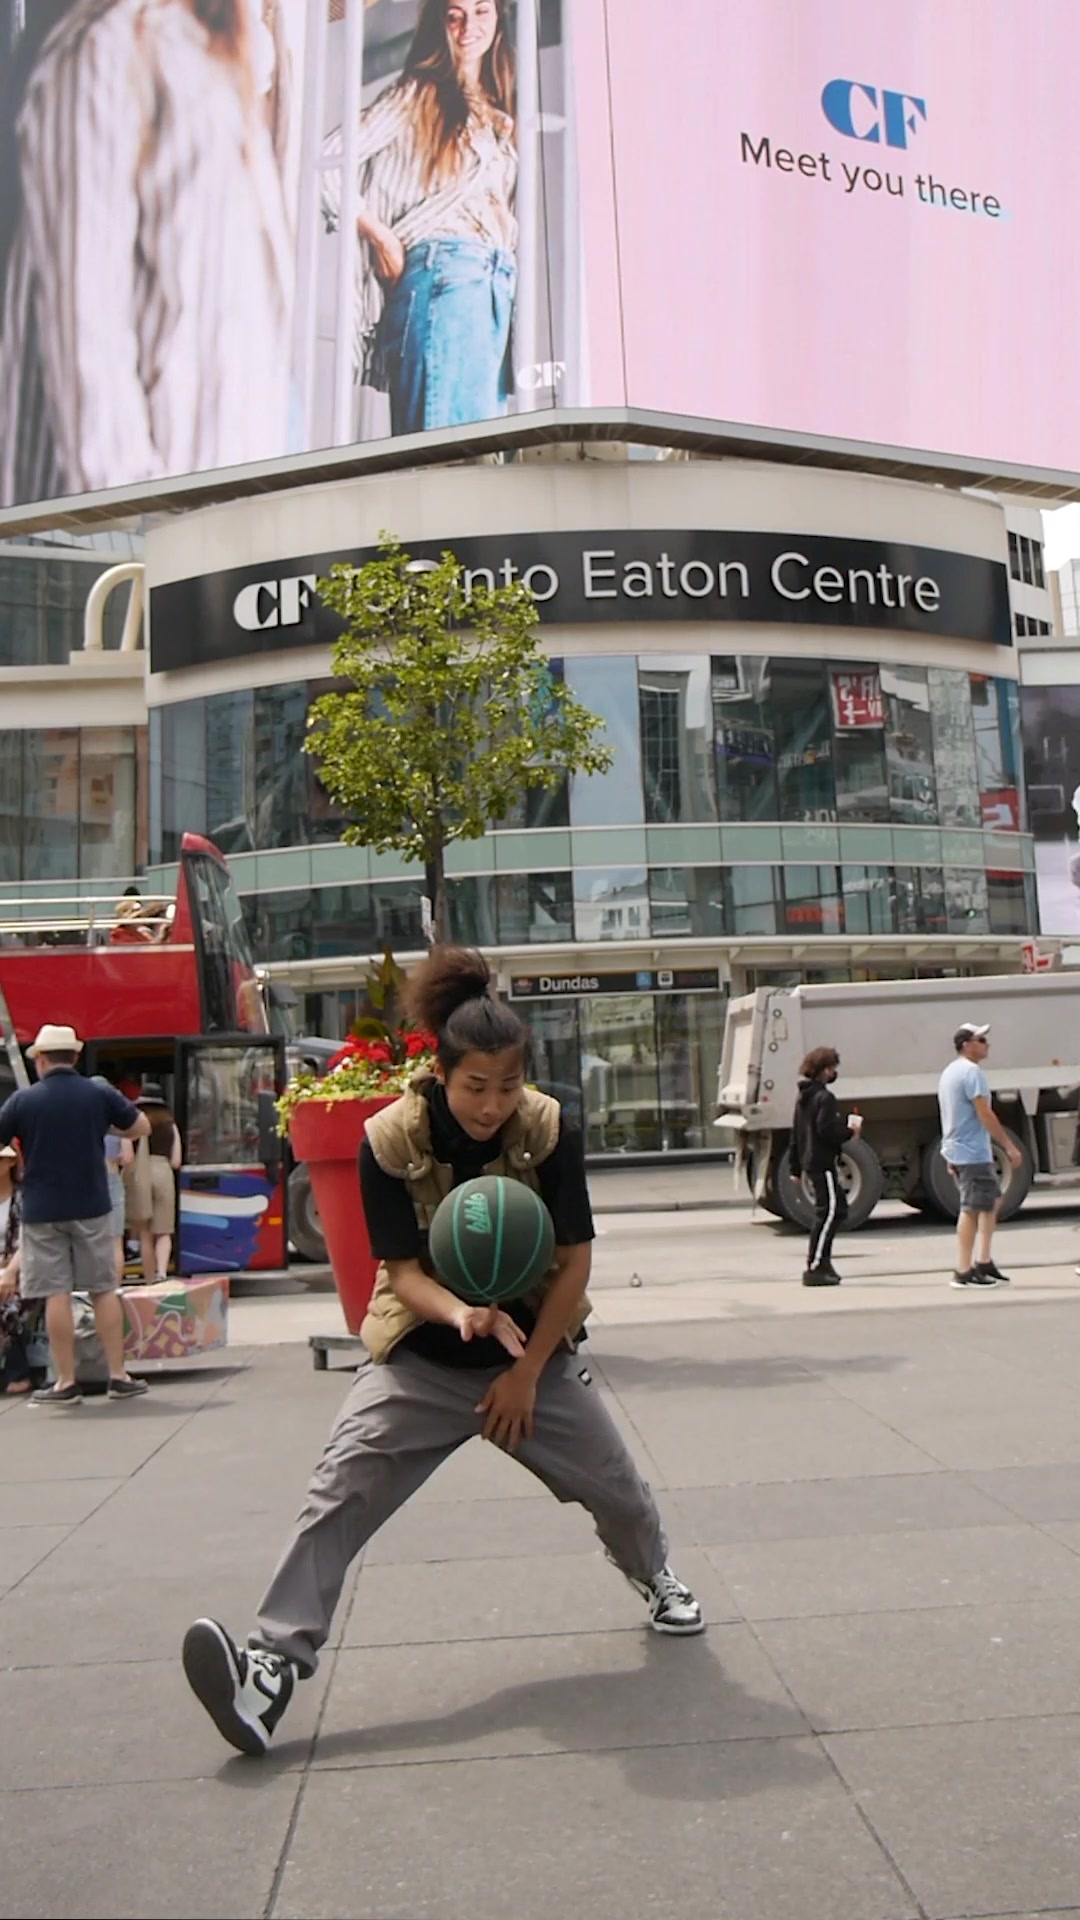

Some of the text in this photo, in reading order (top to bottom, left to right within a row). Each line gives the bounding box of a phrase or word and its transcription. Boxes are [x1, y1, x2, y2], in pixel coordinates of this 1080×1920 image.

[820, 79, 927, 150] CF
[740, 132, 1001, 218] Meet you there
[516, 361, 567, 390] CF
[233, 574, 317, 630] CF
[582, 550, 749, 598] Eaton
[770, 552, 941, 612] Centre
[539, 976, 599, 992] Dundas
